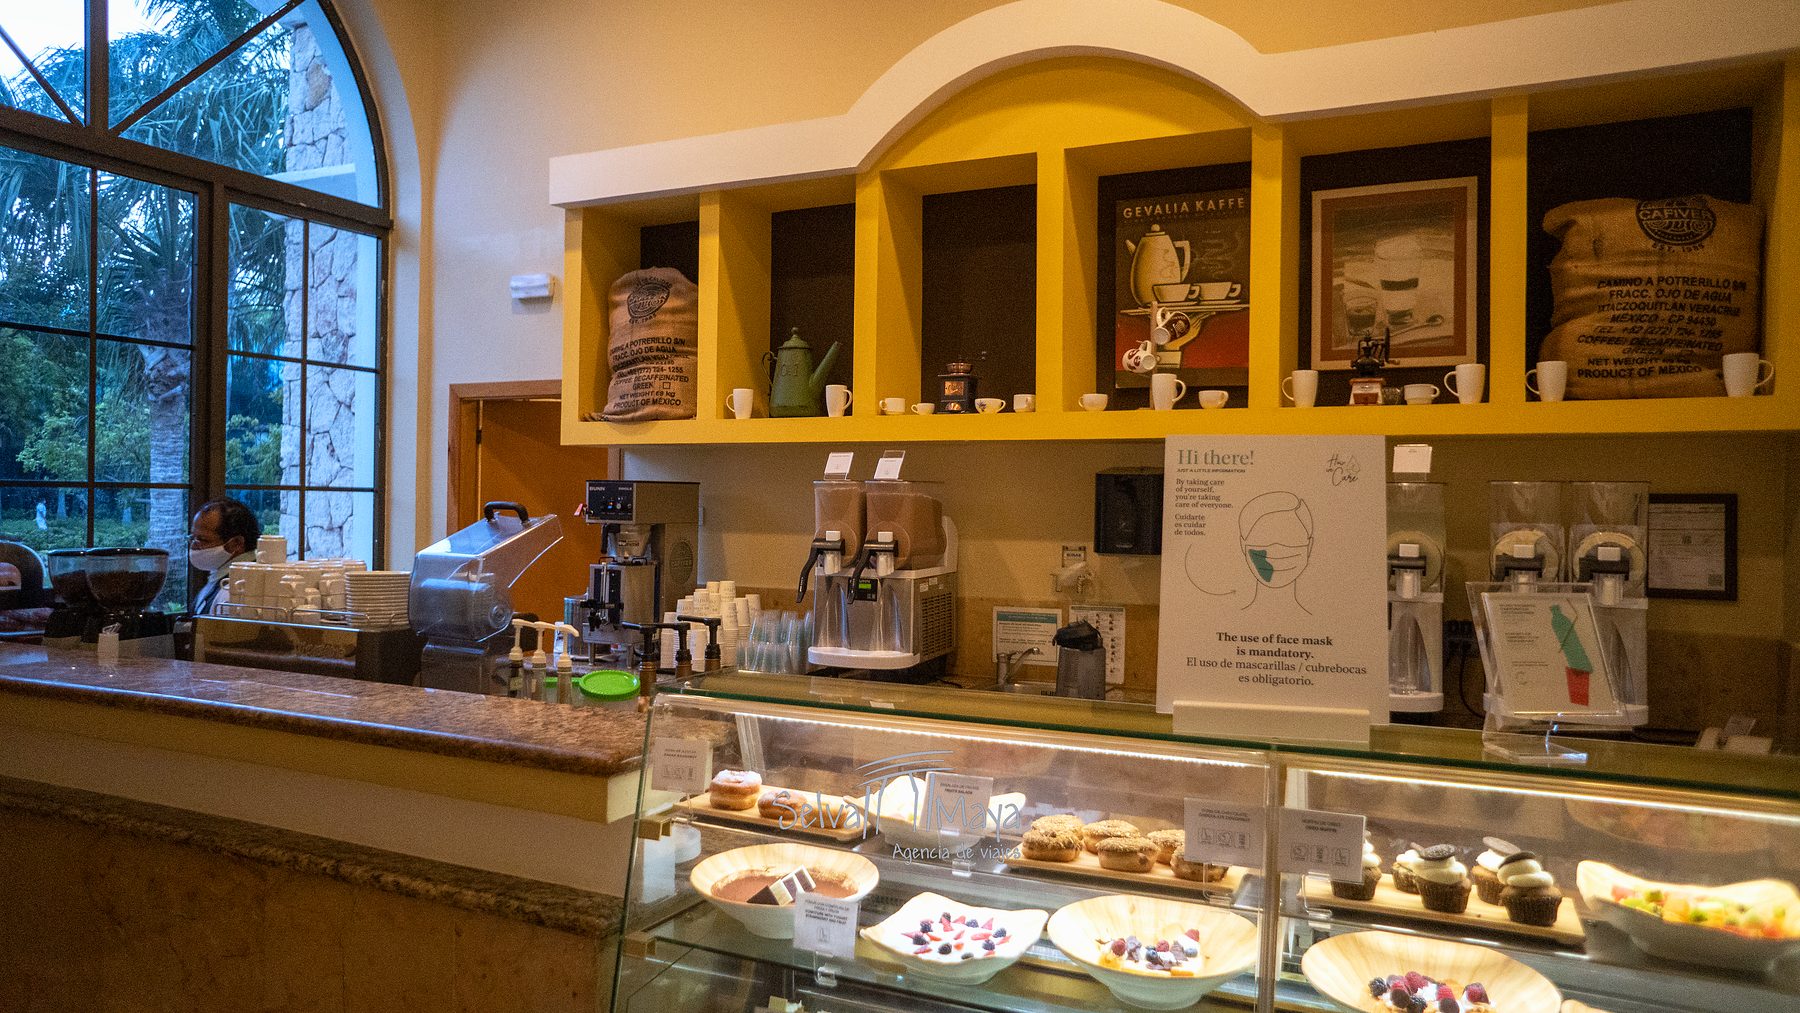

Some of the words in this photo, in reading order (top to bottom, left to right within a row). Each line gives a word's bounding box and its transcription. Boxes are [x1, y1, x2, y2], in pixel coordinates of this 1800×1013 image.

[1123, 201, 1190, 219] GEVALIA
[1195, 197, 1245, 212] KAFFE
[1597, 279, 1642, 289] CAMINO
[1645, 278, 1655, 286] A
[1658, 276, 1731, 289] POTRERILLO
[1610, 289, 1651, 299] FRACC.
[1655, 289, 1681, 299] OJO
[1684, 290, 1702, 300] DE
[1704, 291, 1733, 304] AGUA
[1577, 369, 1633, 378] PRODUCT
[1637, 367, 1654, 377] OF
[1177, 449, 1198, 465] Hi
[1204, 449, 1254, 466] there!
[1176, 478, 1185, 486] By
[1187, 478, 1209, 487] taking
[1332, 466, 1360, 487] Care
[1175, 494, 1197, 502] you're
[1198, 494, 1221, 502] taking
[1175, 513, 1206, 521] Cuidarte
[1217, 632, 1238, 642] The
[1240, 634, 1259, 643] use
[1261, 634, 1275, 644] of
[1275, 634, 1300, 645] face
[1302, 636, 1334, 646] mask
[1236, 647, 1247, 656] is
[1248, 648, 1315, 660] mandatory.
[1186, 657, 1198, 667] El
[1199, 659, 1218, 669] uso
[1220, 658, 1233, 669] de
[1235, 660, 1297, 672] mascarillas
[1305, 662, 1368, 675] cubrebocas
[1238, 674, 1250, 683] es
[1252, 673, 1315, 687] obligatorio.
